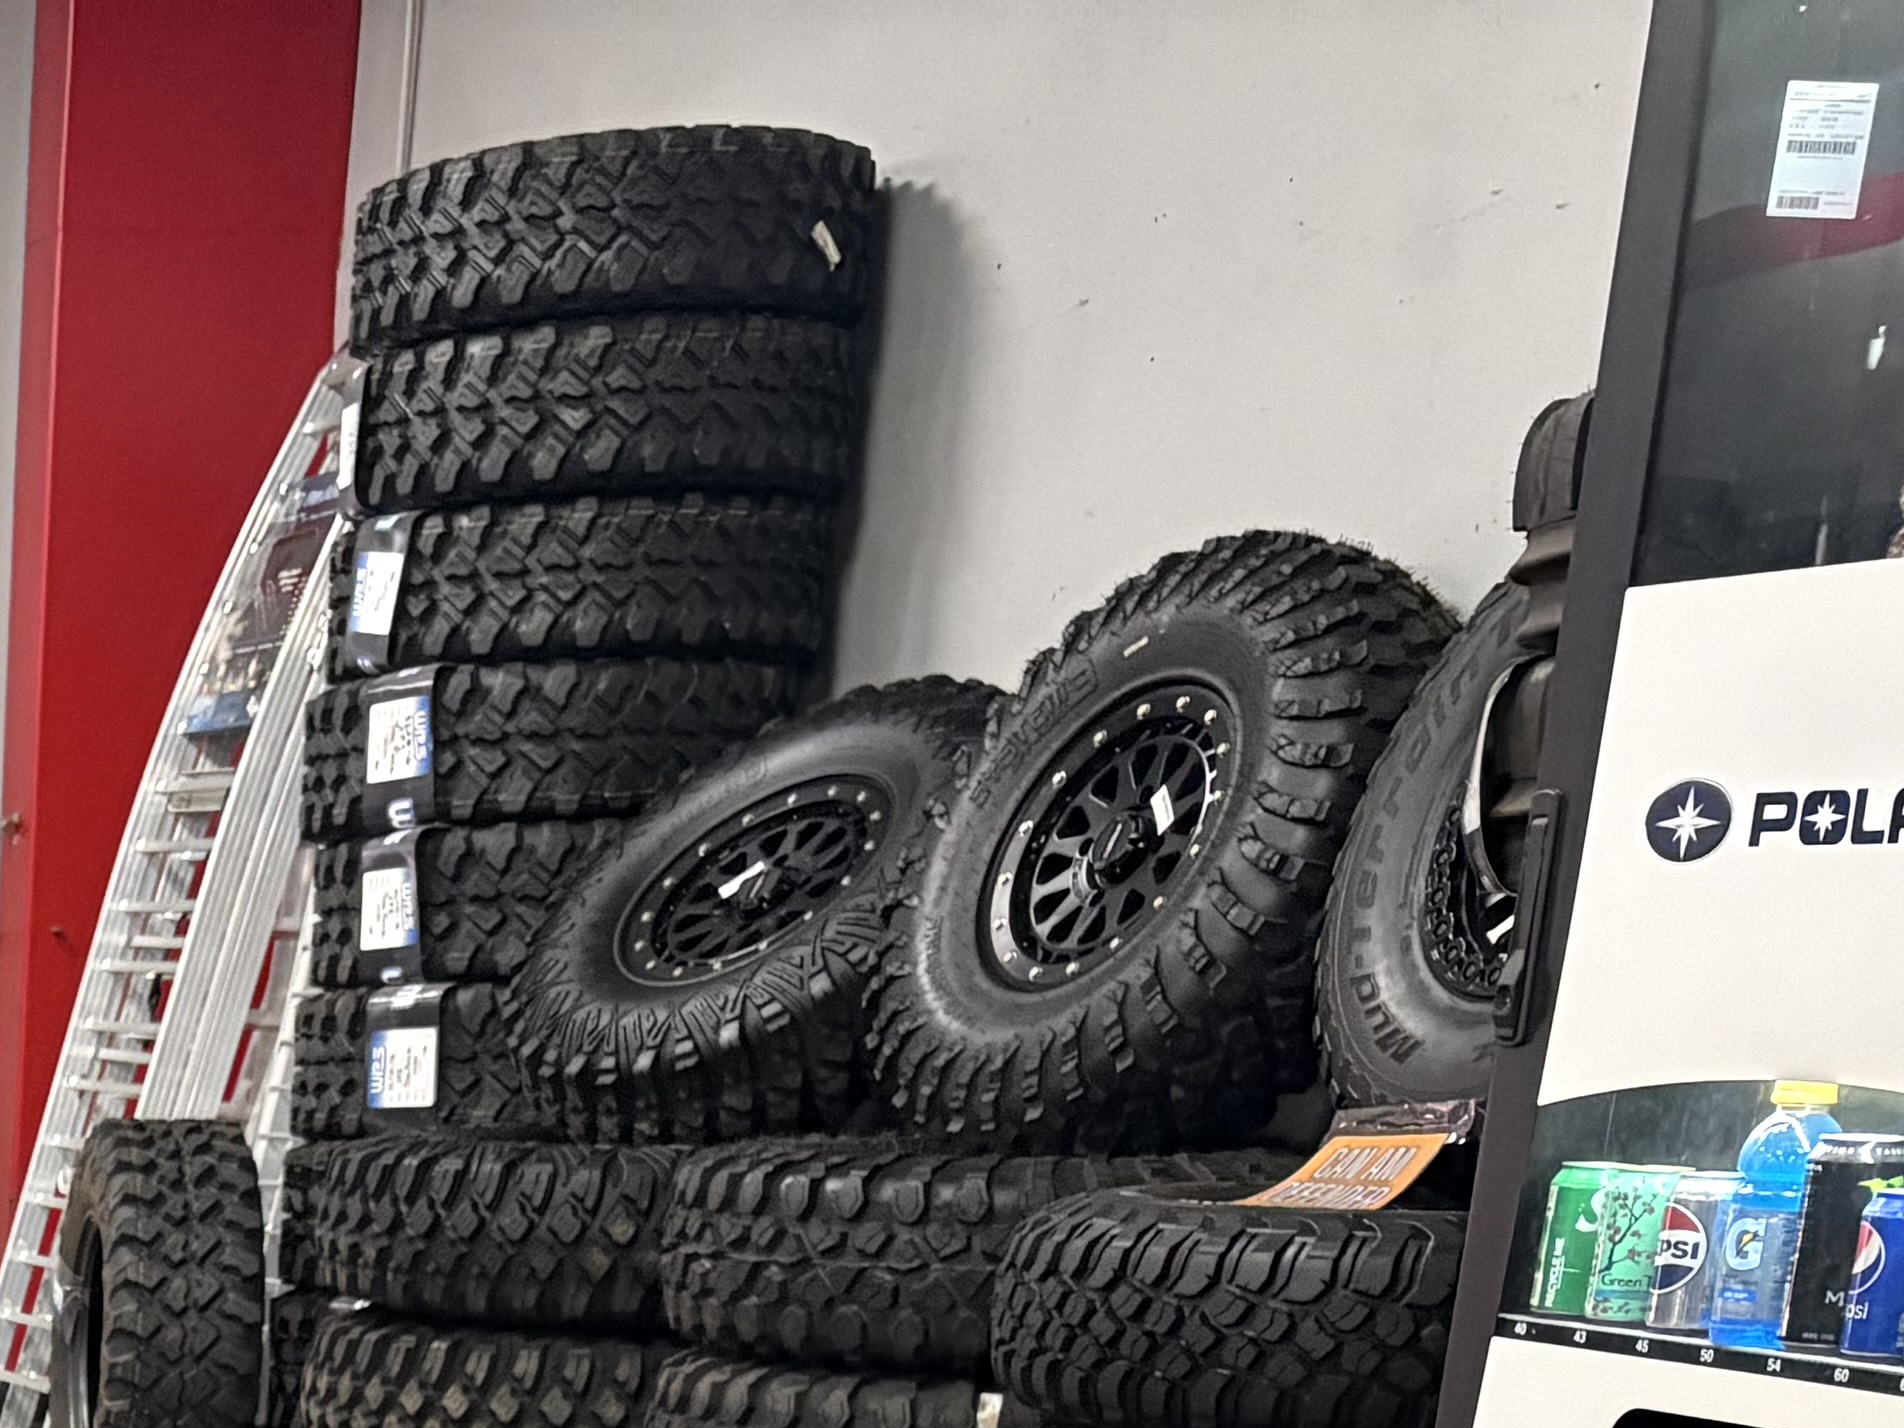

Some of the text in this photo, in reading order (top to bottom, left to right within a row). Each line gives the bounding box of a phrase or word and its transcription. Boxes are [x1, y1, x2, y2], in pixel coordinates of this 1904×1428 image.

[1313, 1147, 1418, 1181] CAN AM
[1269, 1182, 1391, 1209] DEFENDER
[1660, 1240, 1700, 1260] PSI
[1725, 1218, 1767, 1271] G
[1601, 1273, 1642, 1287] Green
[1573, 1330, 1587, 1343] 43
[1635, 1340, 1649, 1353] 45
[1700, 1349, 1714, 1362] 50
[1766, 1358, 1781, 1372] 54
[1833, 1367, 1850, 1383] 60
